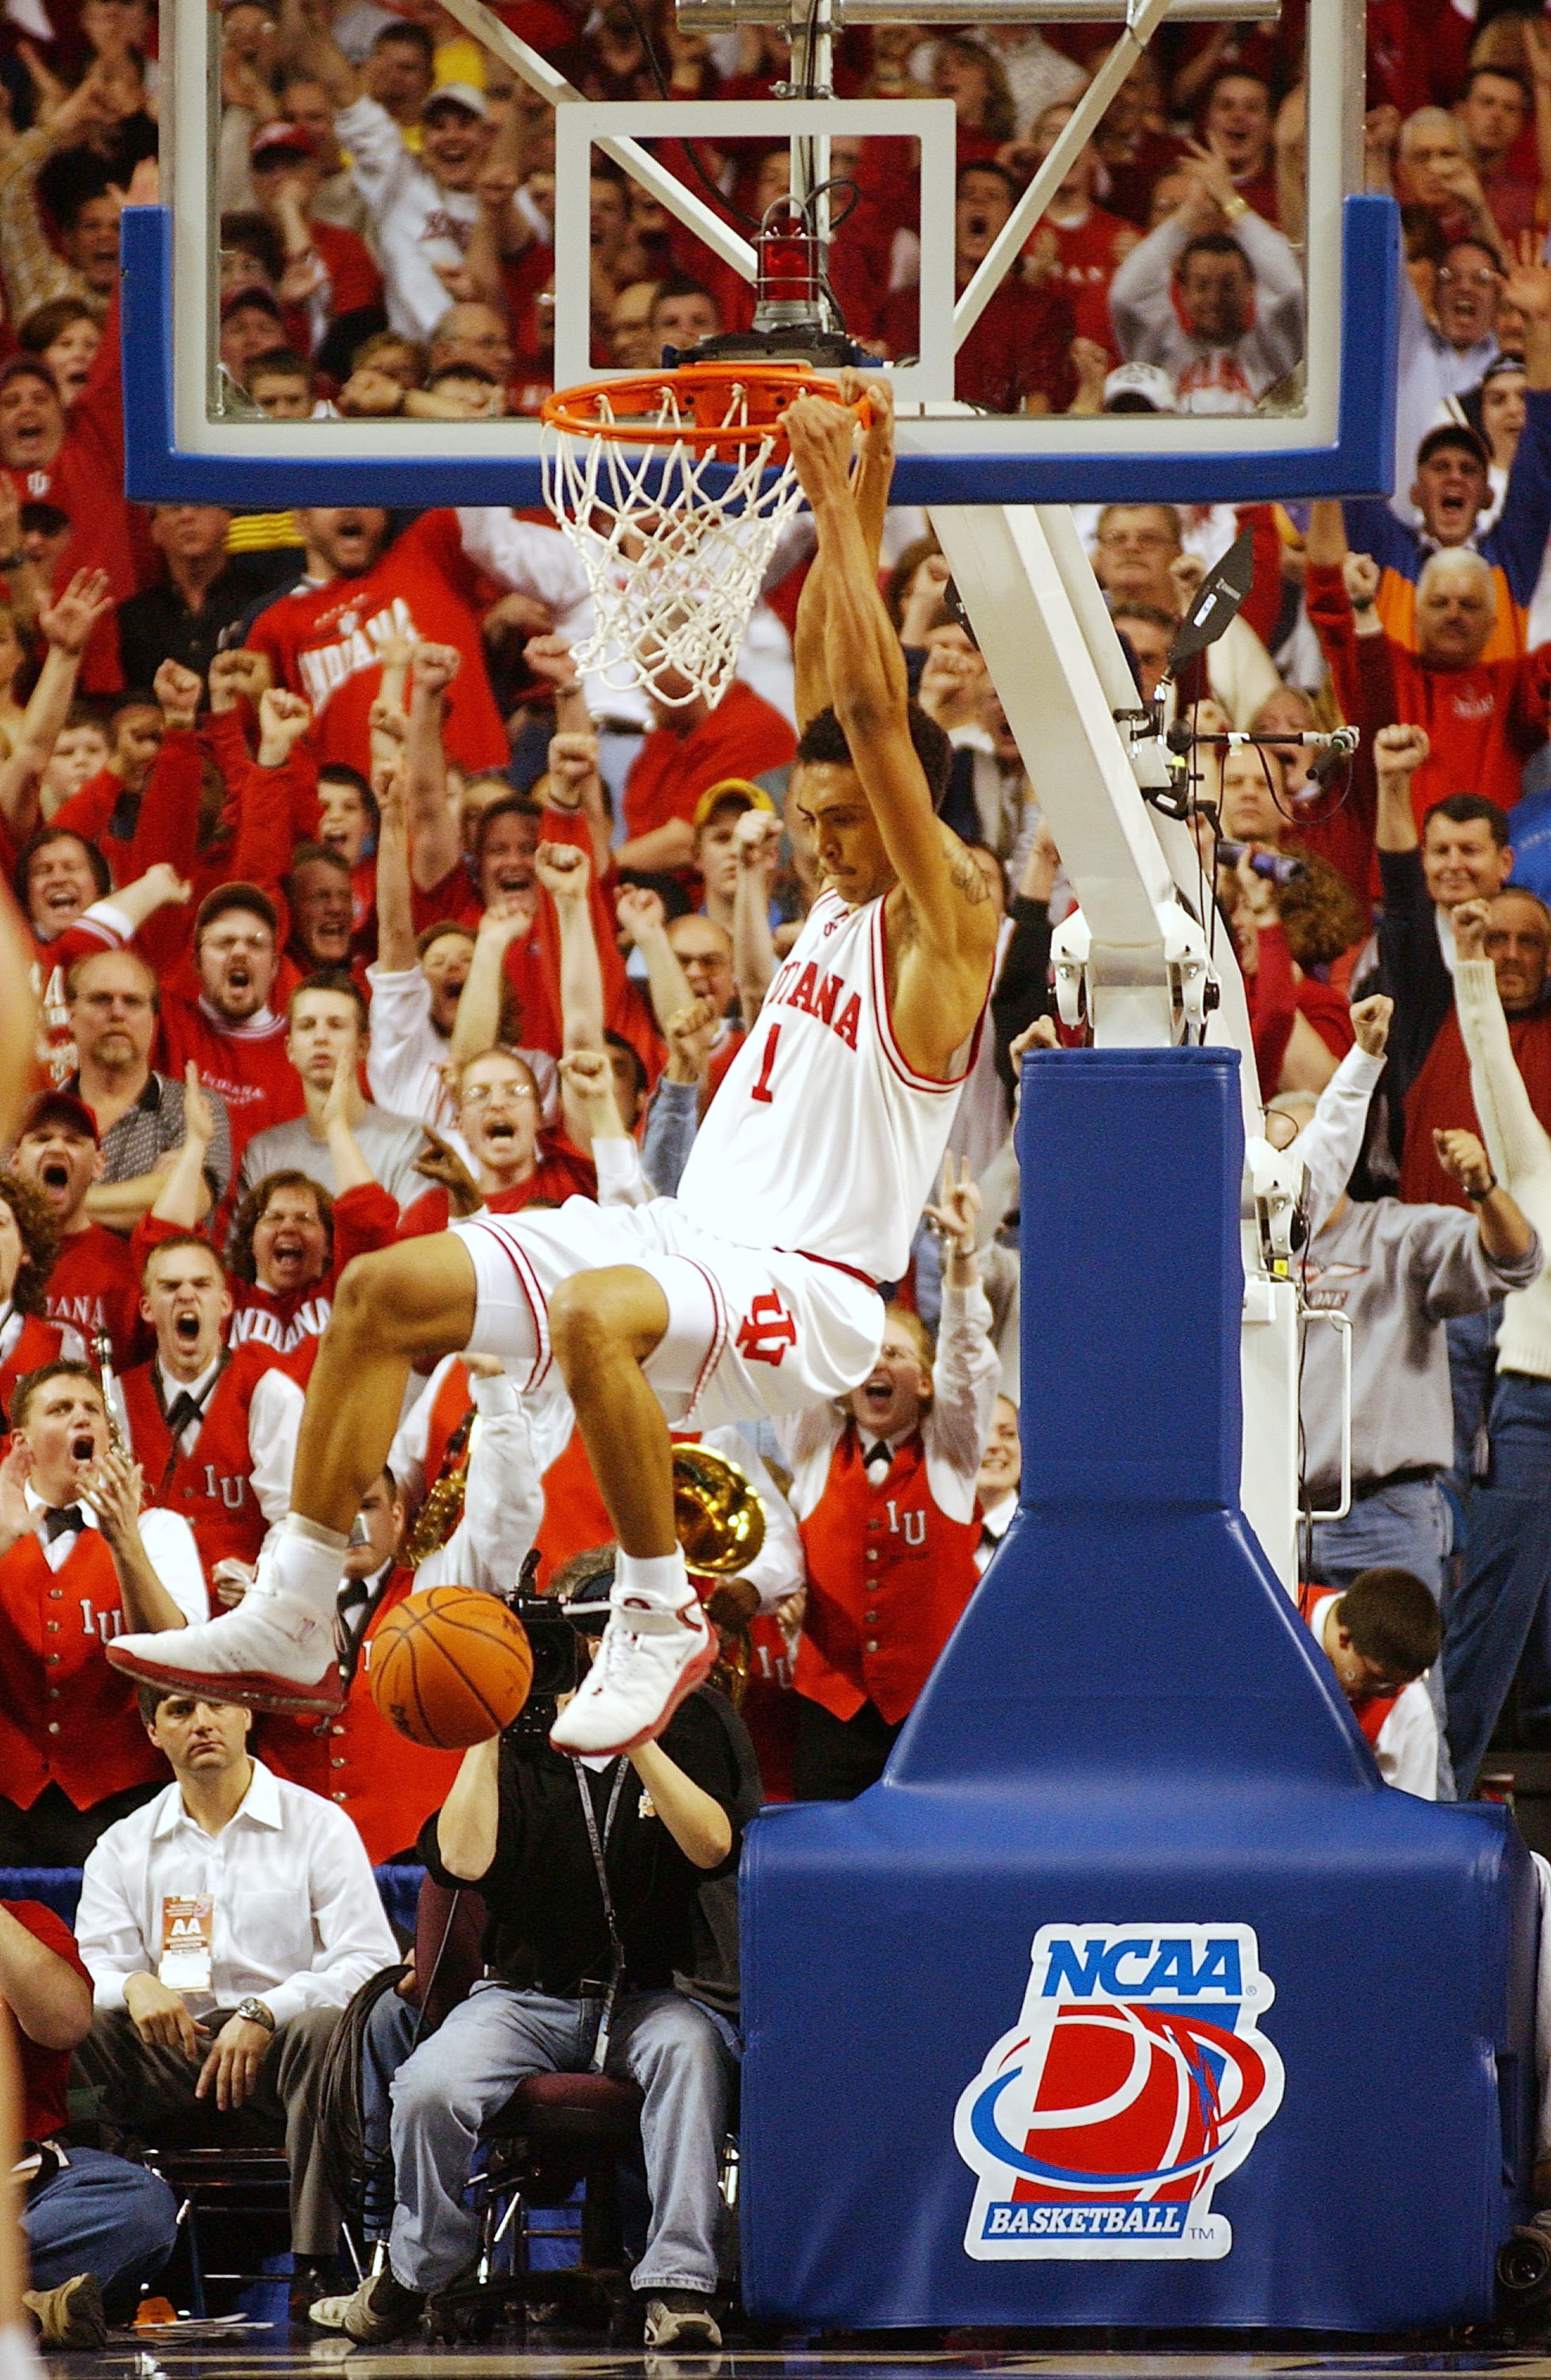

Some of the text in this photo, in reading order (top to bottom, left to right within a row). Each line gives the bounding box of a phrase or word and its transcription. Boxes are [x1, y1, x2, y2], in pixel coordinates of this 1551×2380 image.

[751, 1023, 781, 1103] 1
[204, 1464, 244, 1508] IU
[886, 1500, 925, 1545] IU
[80, 1599, 121, 1644] IU
[170, 1917, 202, 1936] AA
[1041, 1939, 1243, 1997] NCAA
[989, 2207, 1181, 2234] BASKETBALL
